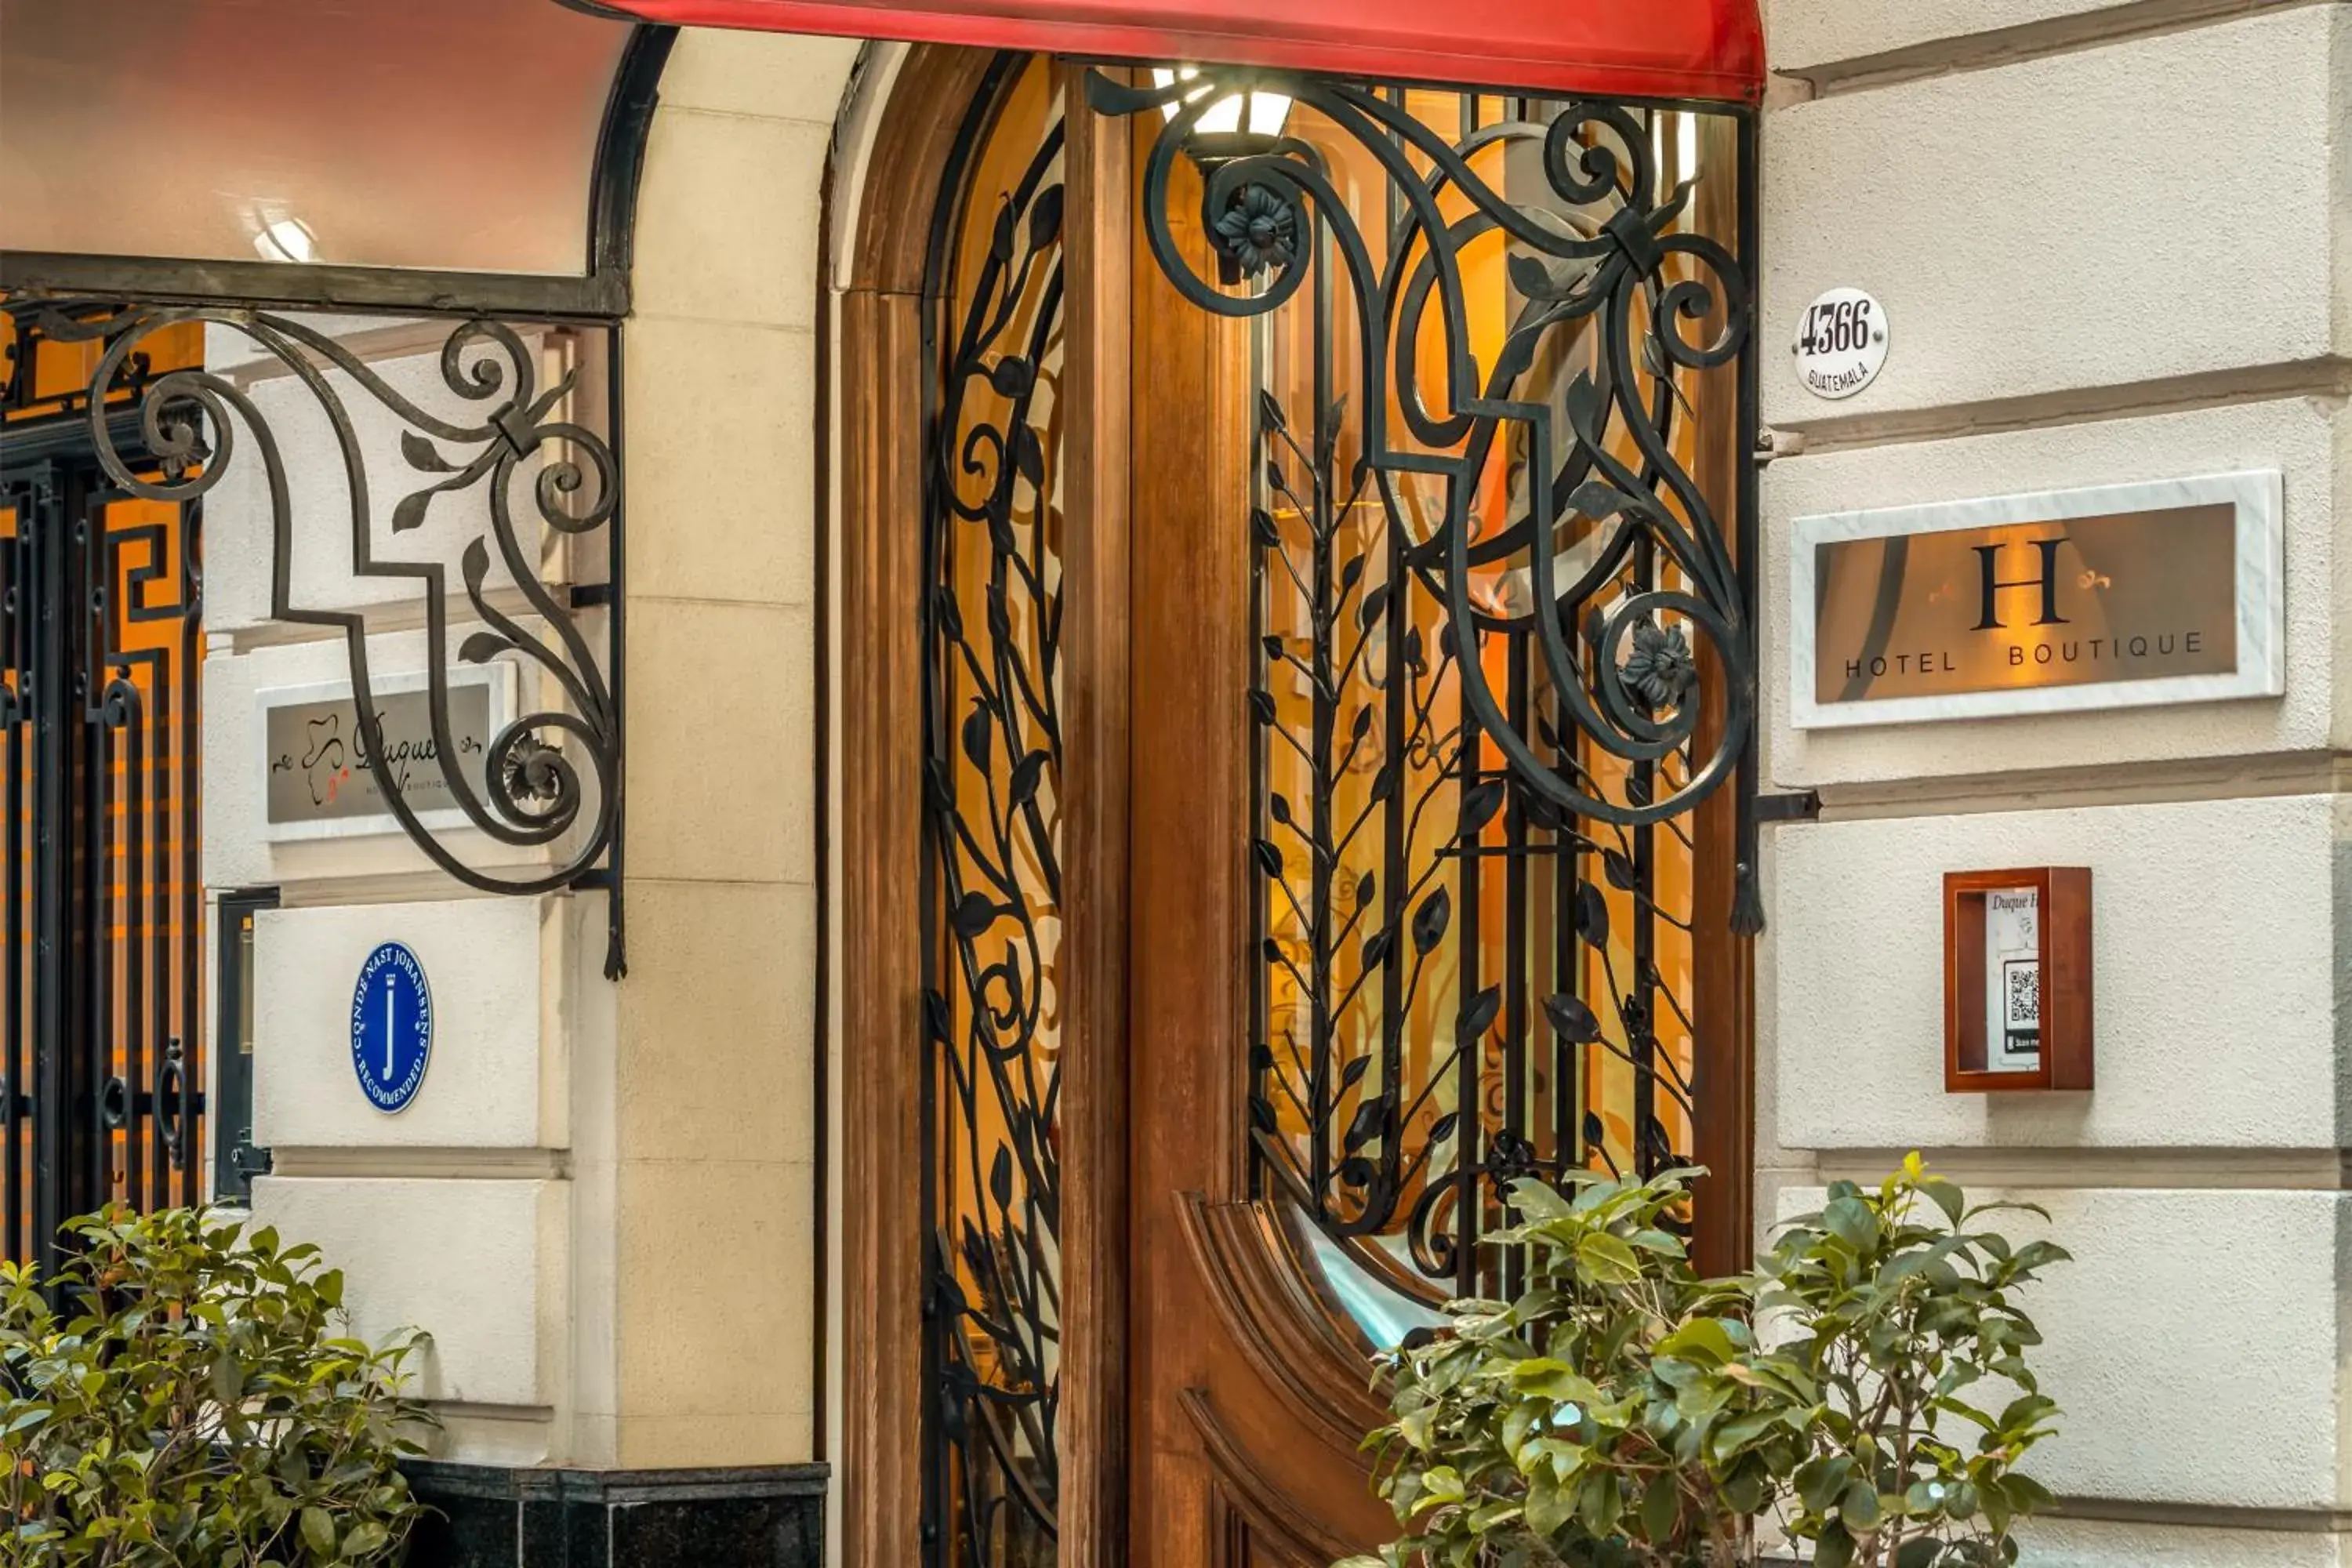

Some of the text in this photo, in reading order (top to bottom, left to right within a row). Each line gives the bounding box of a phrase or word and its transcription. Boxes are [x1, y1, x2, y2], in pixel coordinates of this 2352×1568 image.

[1801, 299, 1871, 356] 4366
[1809, 361, 1869, 392] GUATEMALA
[1969, 537, 2071, 631] H
[1846, 632, 2202, 679] HOTEL BOUTIQUE
[1992, 895, 2028, 913] Duque
[366, 948, 393, 978] NAST
[394, 949, 429, 1048] JOHANSENS
[358, 1058, 422, 1105] RECOMMENDED
